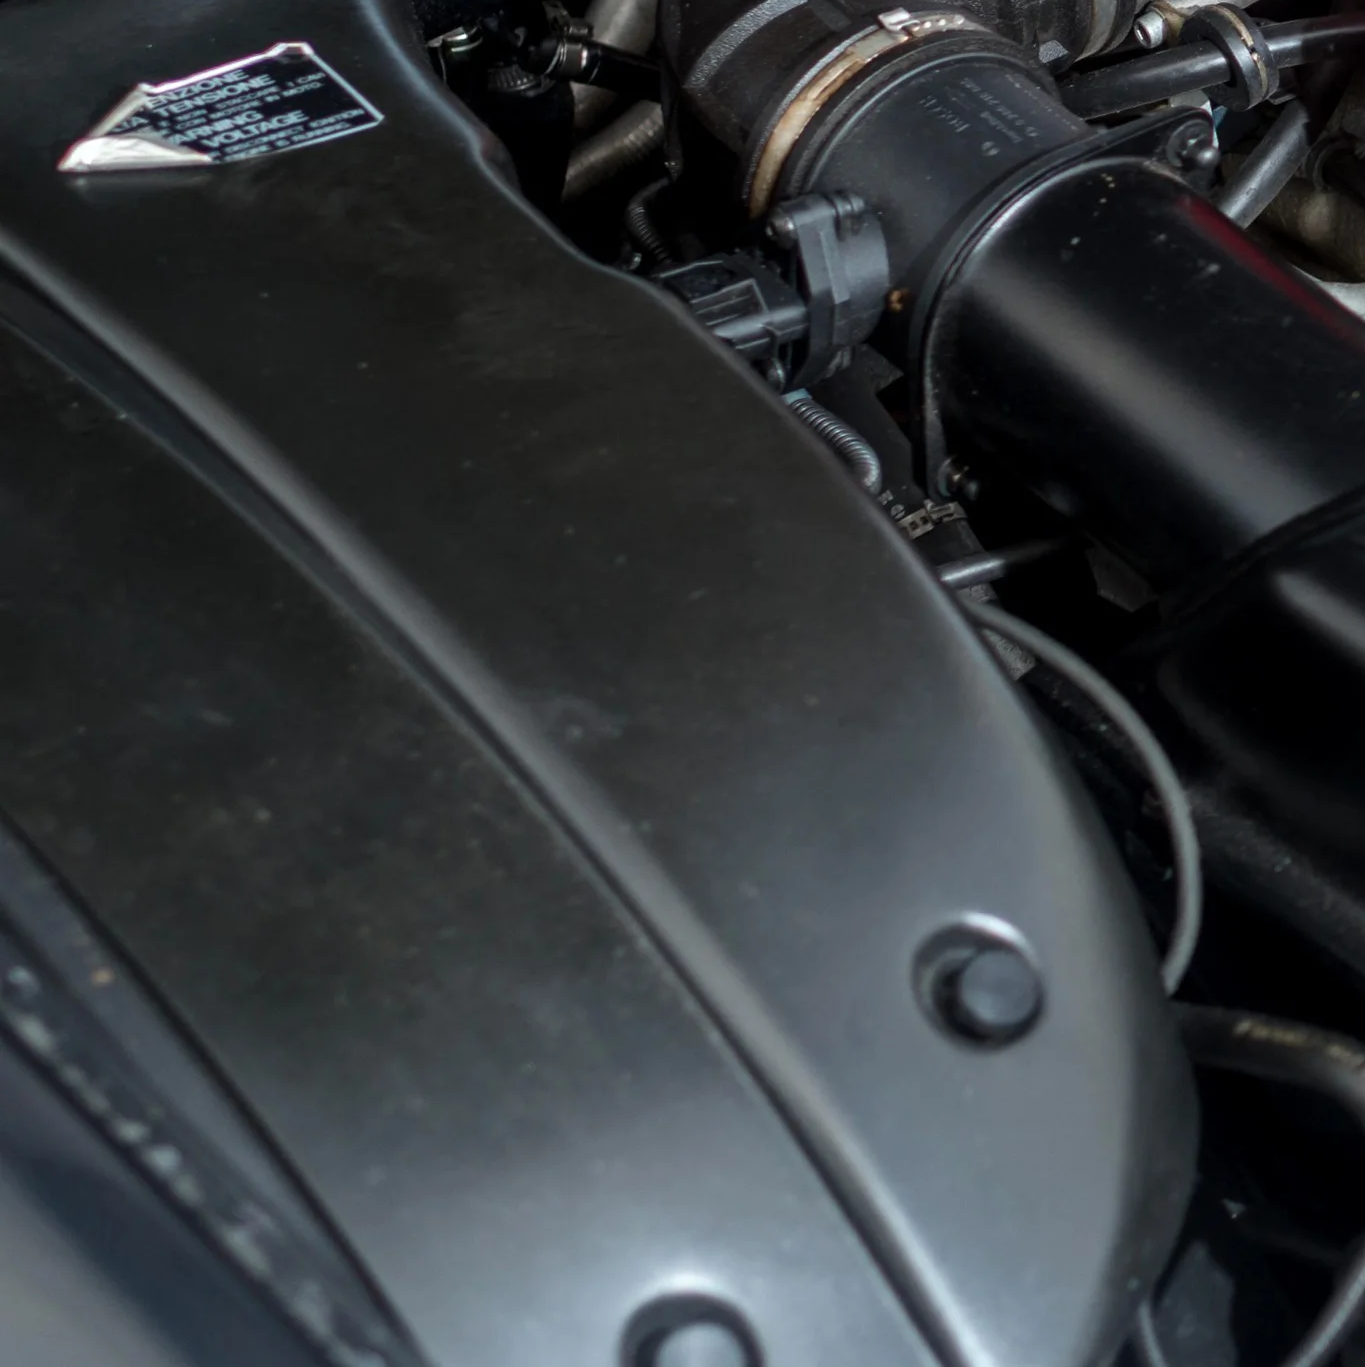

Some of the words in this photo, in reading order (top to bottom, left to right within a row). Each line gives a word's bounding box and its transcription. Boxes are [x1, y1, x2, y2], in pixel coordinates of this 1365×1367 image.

[146, 68, 251, 109] ENZIONE
[152, 73, 276, 118] TENSIONE
[199, 109, 310, 149] VOLTAGE
